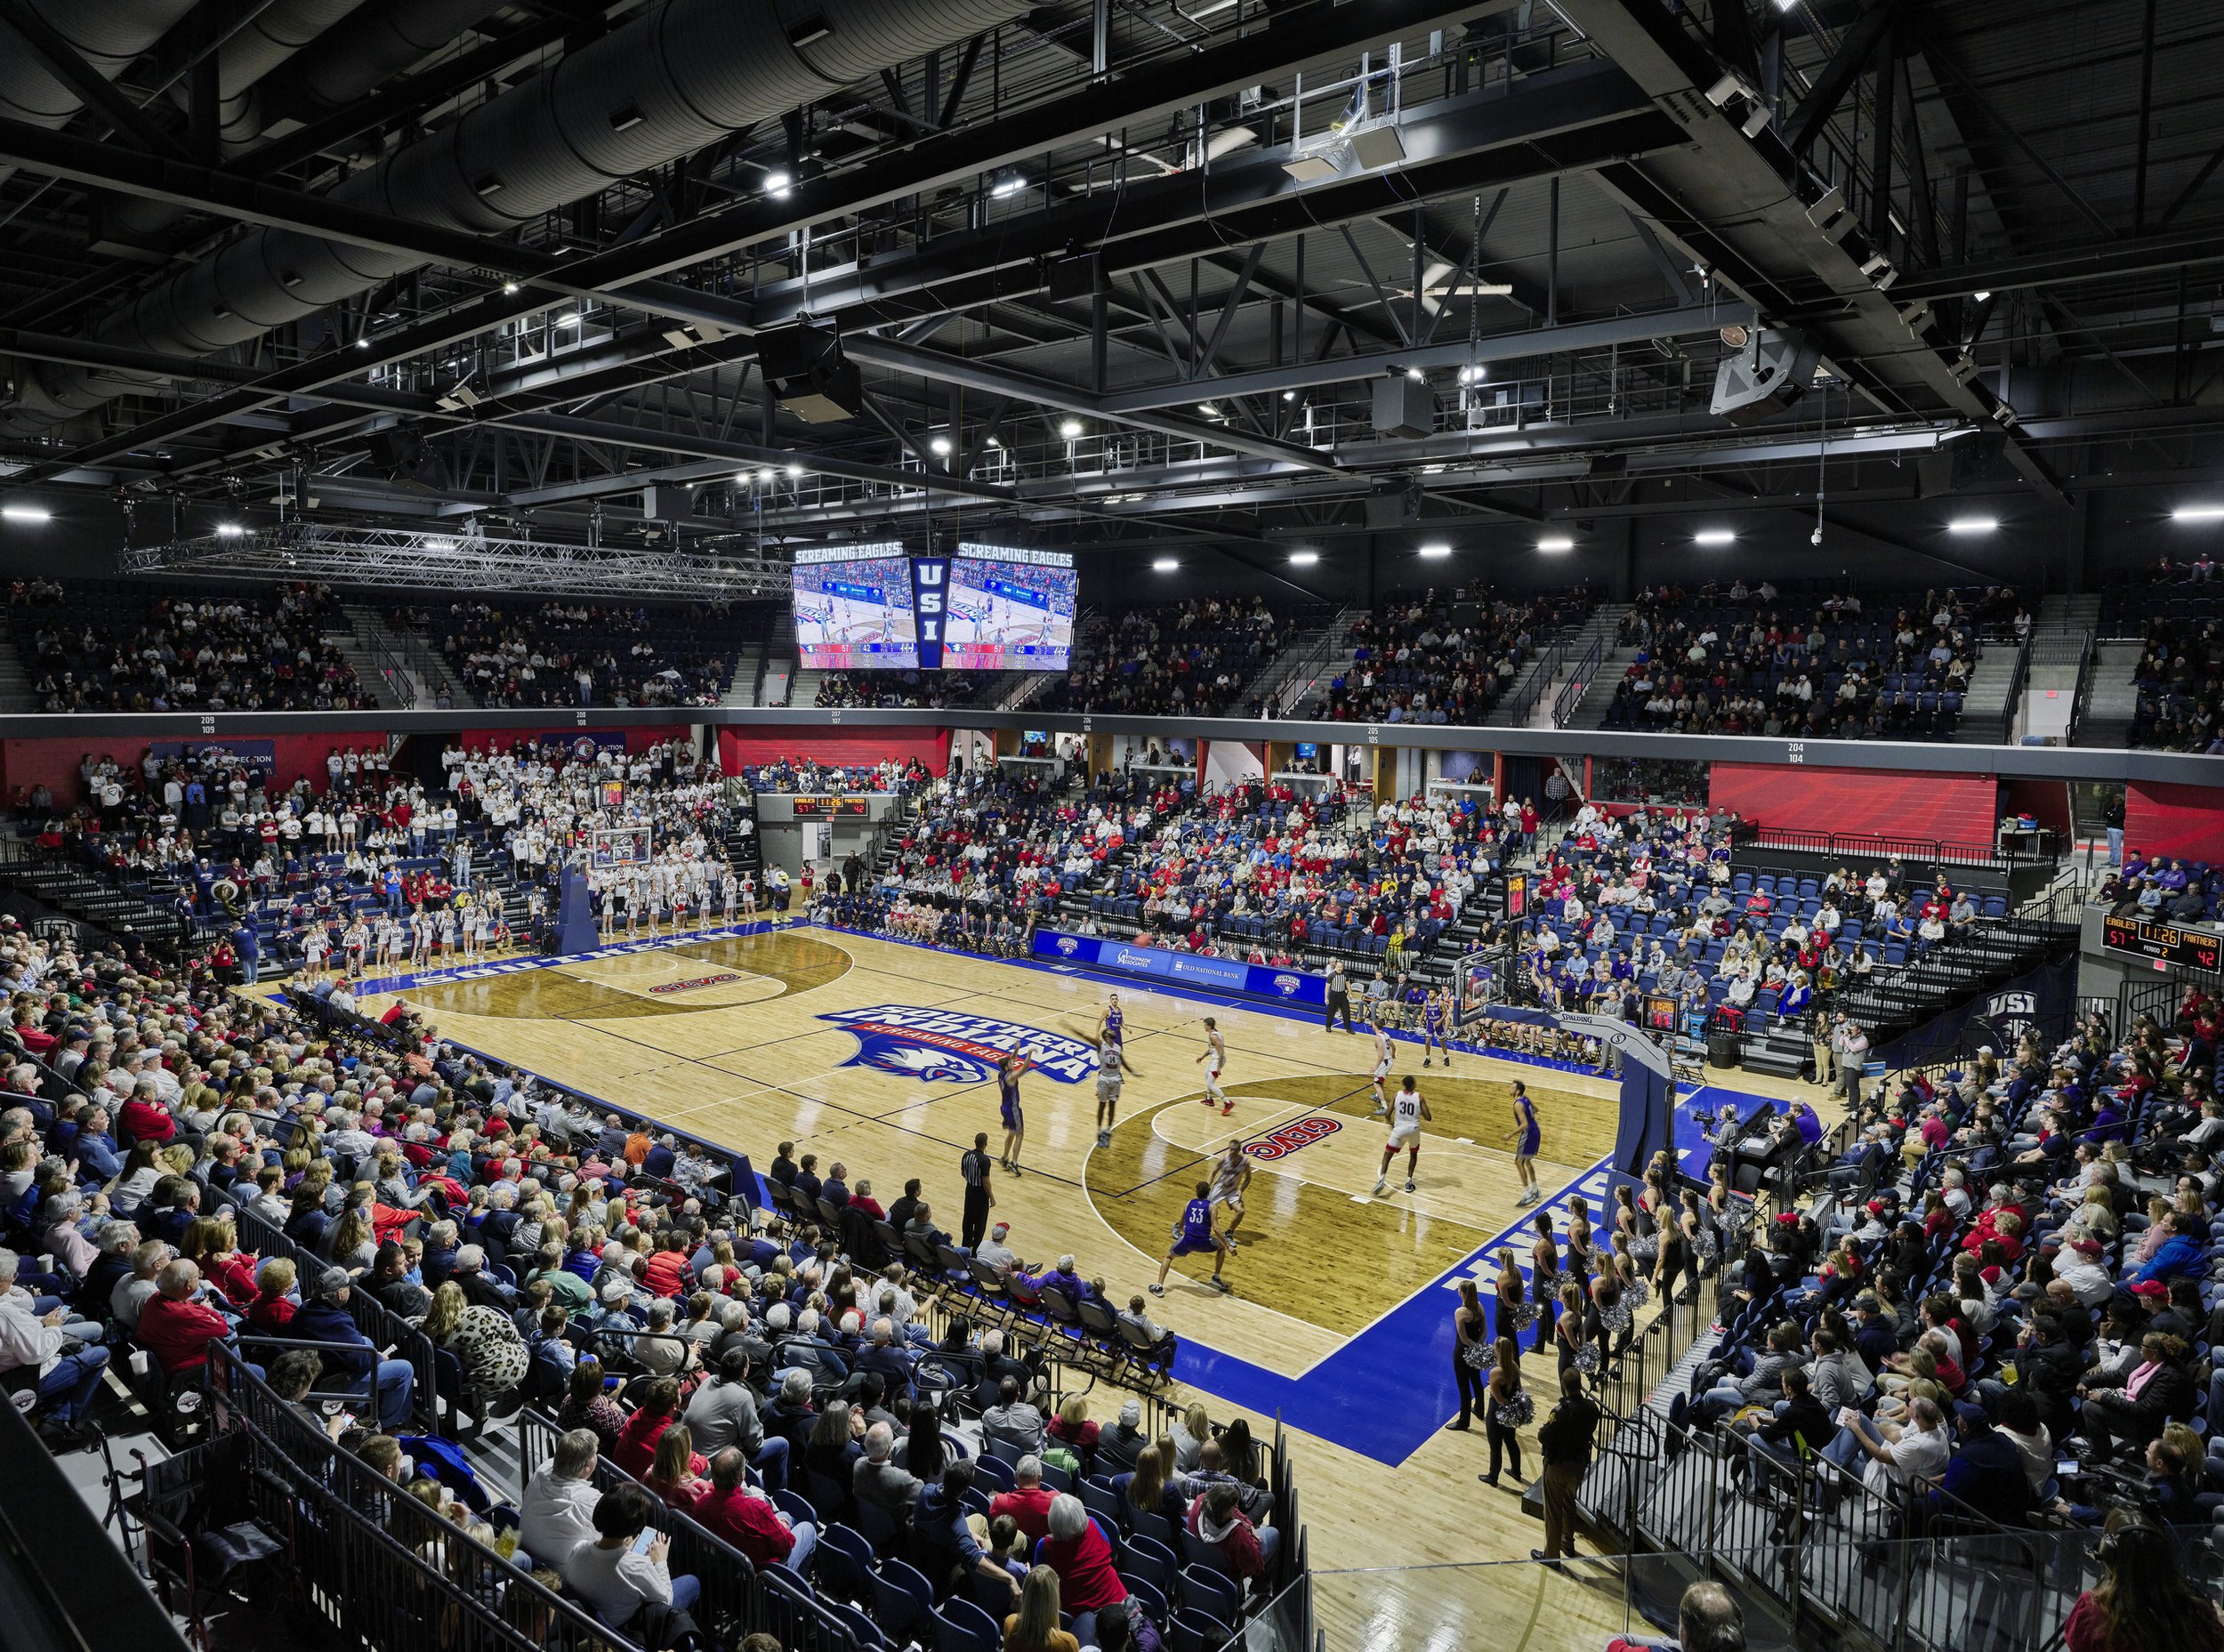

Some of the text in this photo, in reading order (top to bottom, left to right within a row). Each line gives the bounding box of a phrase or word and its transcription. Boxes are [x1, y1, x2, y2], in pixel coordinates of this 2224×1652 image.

[795, 542, 903, 563] SCREAMING EAGLES
[958, 543, 1073, 567] SCREAMING EAGLES
[201, 716, 214, 724] 209
[202, 726, 215, 734] 109
[1788, 743, 1804, 752] 204
[1789, 753, 1803, 762] 104
[2106, 916, 2218, 947] EAGLES 11:26 PANTHERS
[411, 931, 742, 985] SOUTHERN
[2110, 931, 2214, 966] 57 PERIOD 2 42
[1196, 966, 1223, 977] NATIONAL
[1223, 971, 1240, 979] BANK
[1988, 993, 2035, 1018] USI
[1561, 1014, 1592, 1024] SPALDING
[831, 1009, 1091, 1080] INDIANA
[864, 1022, 964, 1052] SCREAMING
[879, 1005, 1102, 1069] SOUTHERN
[1399, 1101, 1414, 1116] 30
[1189, 1207, 1205, 1224] 33
